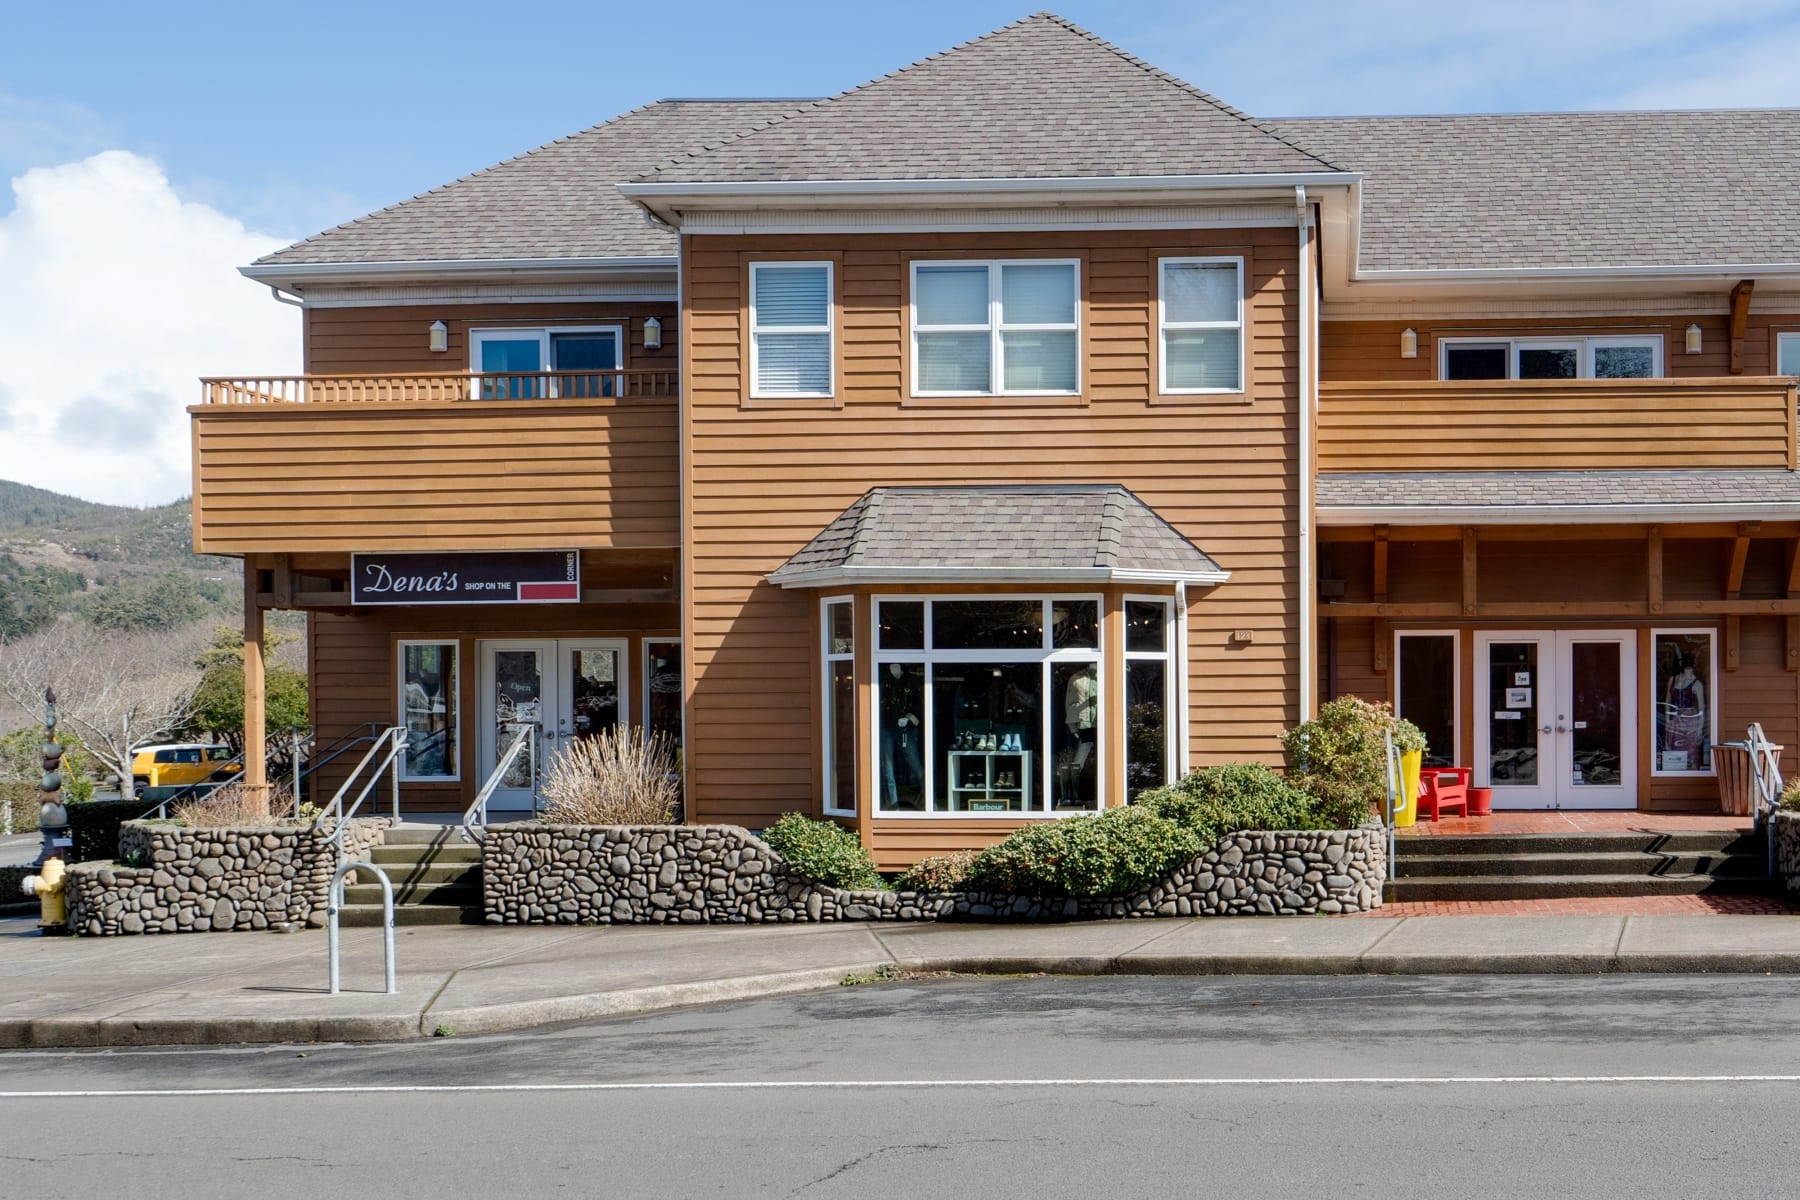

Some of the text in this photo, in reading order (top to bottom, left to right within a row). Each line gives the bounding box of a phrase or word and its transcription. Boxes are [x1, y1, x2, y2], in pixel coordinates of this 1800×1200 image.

[566, 552, 575, 581] CORNER
[362, 564, 458, 592] Dena's
[464, 582, 512, 591] SHOP ON THE
[510, 681, 531, 693] Open
